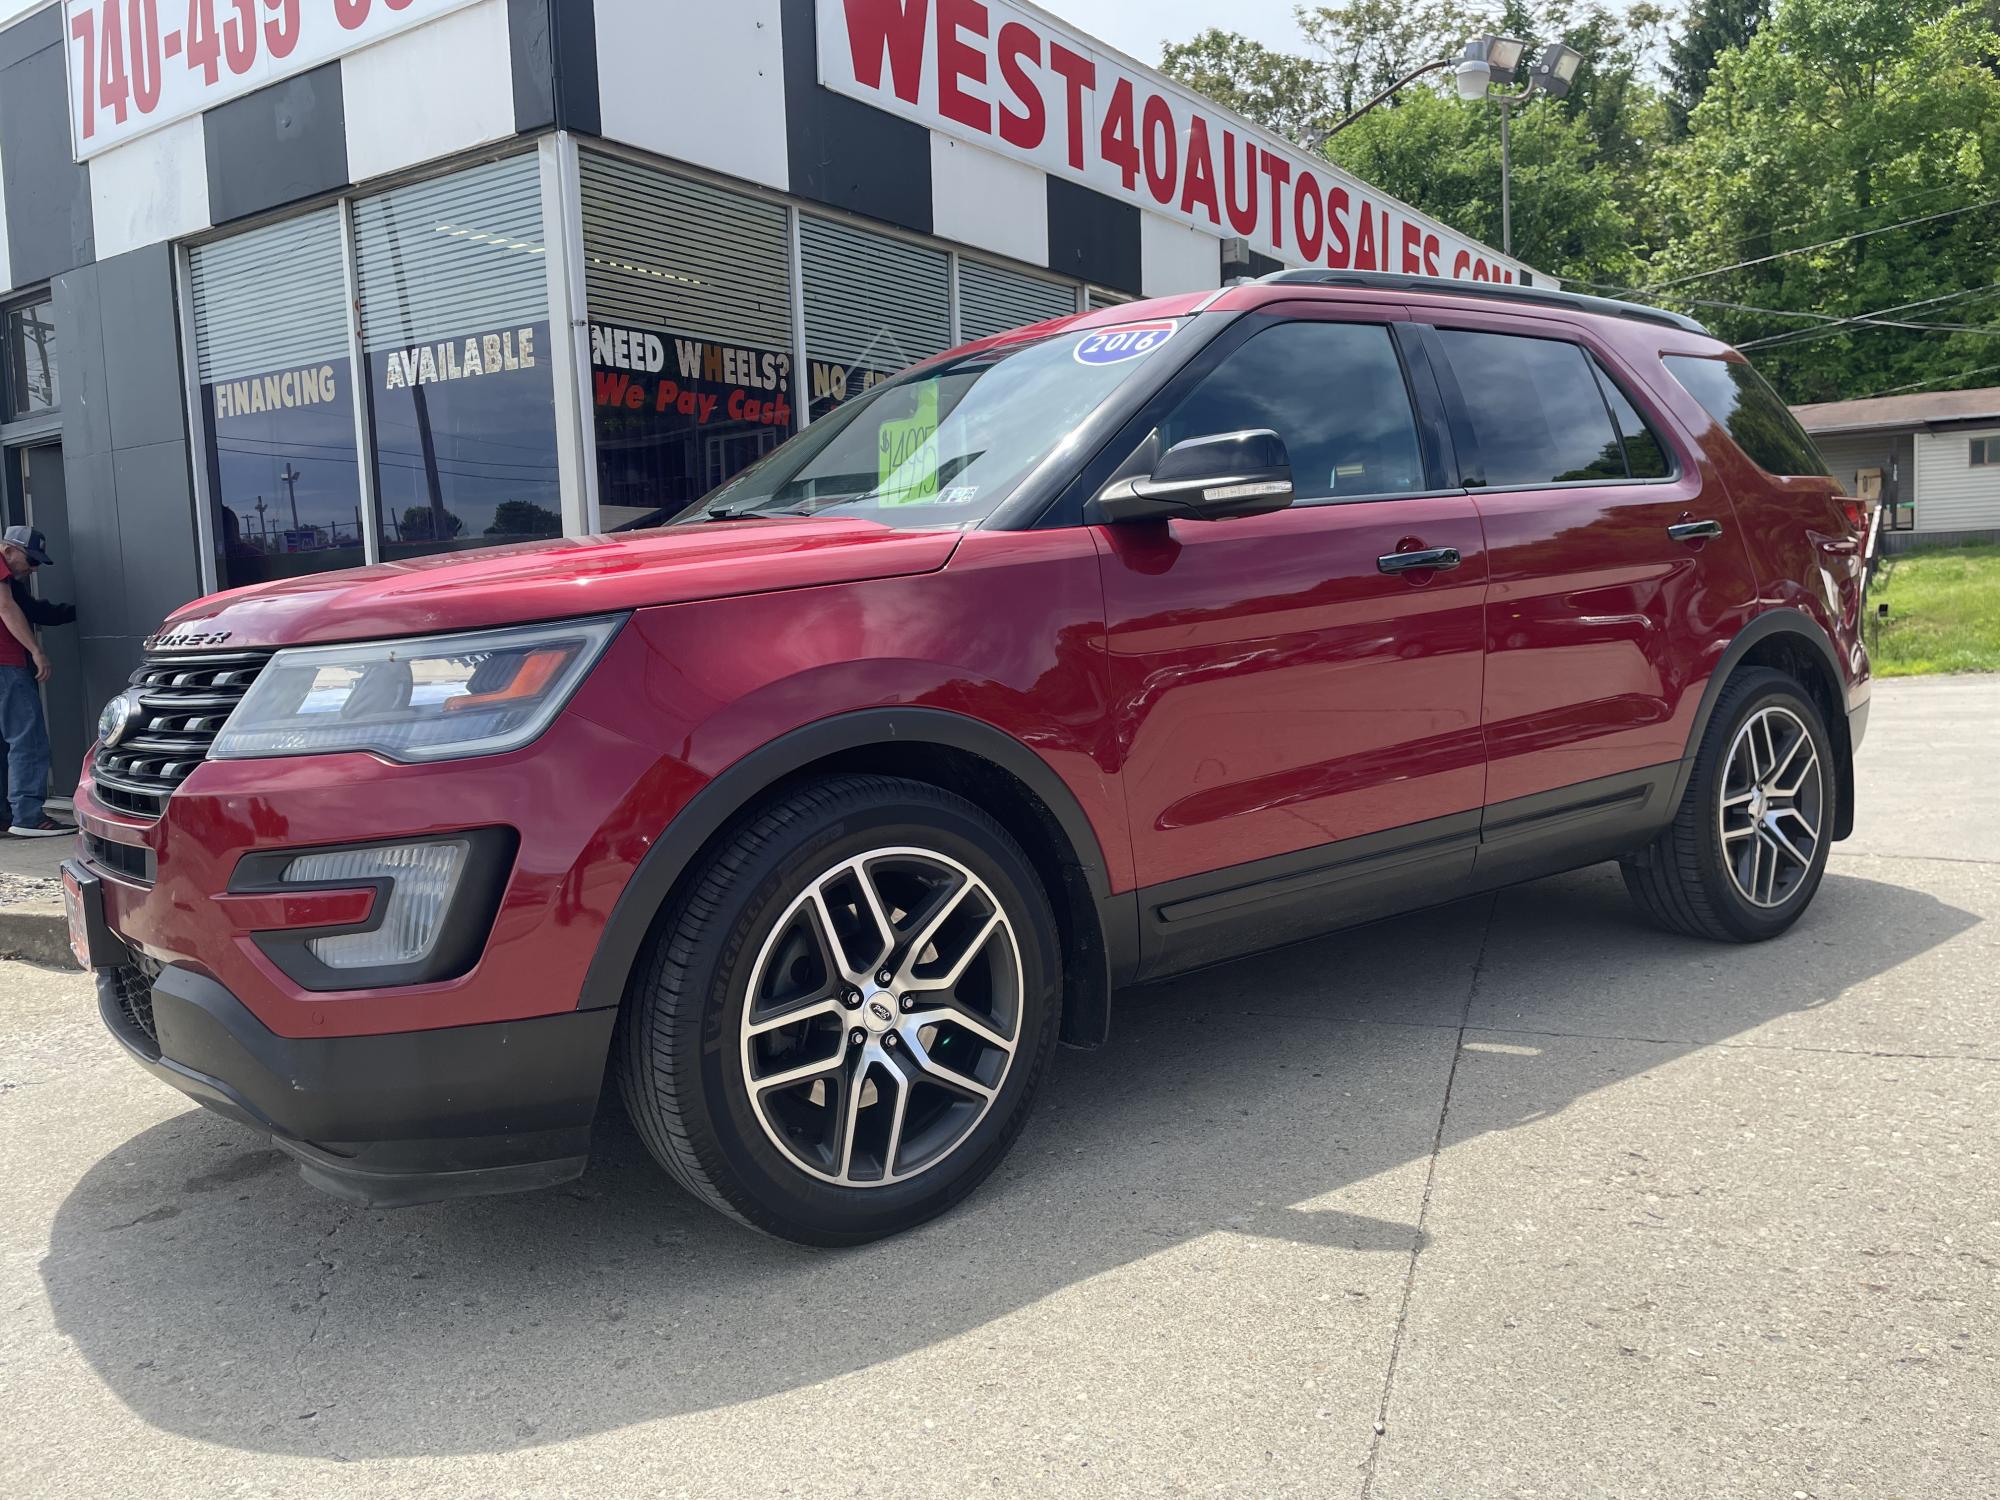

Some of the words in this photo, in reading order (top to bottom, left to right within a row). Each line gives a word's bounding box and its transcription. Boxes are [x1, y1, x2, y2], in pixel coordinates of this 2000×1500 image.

[71, 0, 414, 140] 740-439
[843, 0, 1513, 284] WEST40AUTOSALESC
[385, 327, 535, 390] AVAILABLE
[591, 324, 665, 373] NEED
[674, 338, 790, 391] WHEELS?
[1083, 331, 1156, 354] 2016
[215, 366, 336, 419] FINANCING
[594, 371, 645, 408] We
[656, 380, 717, 424] Pay
[727, 388, 791, 426] Cash
[813, 361, 847, 400] NO
[880, 424, 937, 503] $14995
[872, 1003, 891, 1021] Ford
